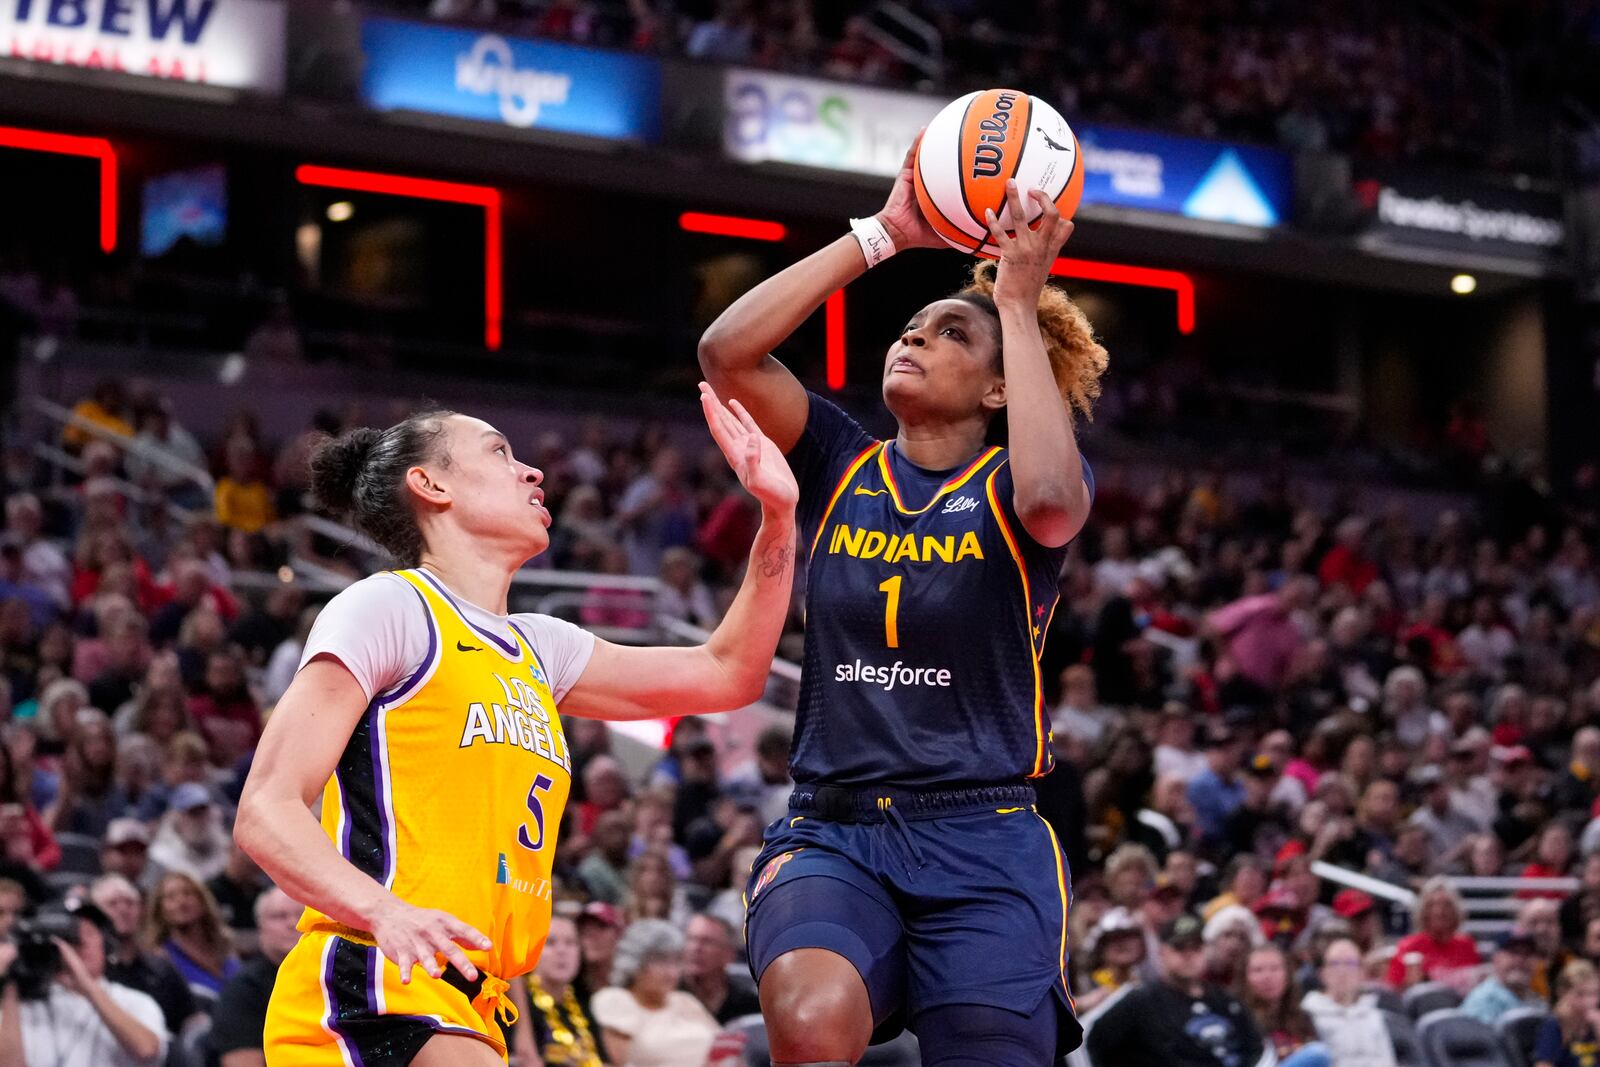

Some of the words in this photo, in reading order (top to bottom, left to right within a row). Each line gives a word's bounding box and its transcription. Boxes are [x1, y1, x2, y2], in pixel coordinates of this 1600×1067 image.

[455, 33, 570, 127] Kroger
[972, 92, 1018, 180] Wilson
[941, 495, 980, 514] Lilly
[829, 524, 984, 563] INDIANA
[879, 575, 902, 648] 1
[491, 672, 550, 723] LOS
[835, 659, 951, 691] salesforce
[517, 772, 554, 851] 5
